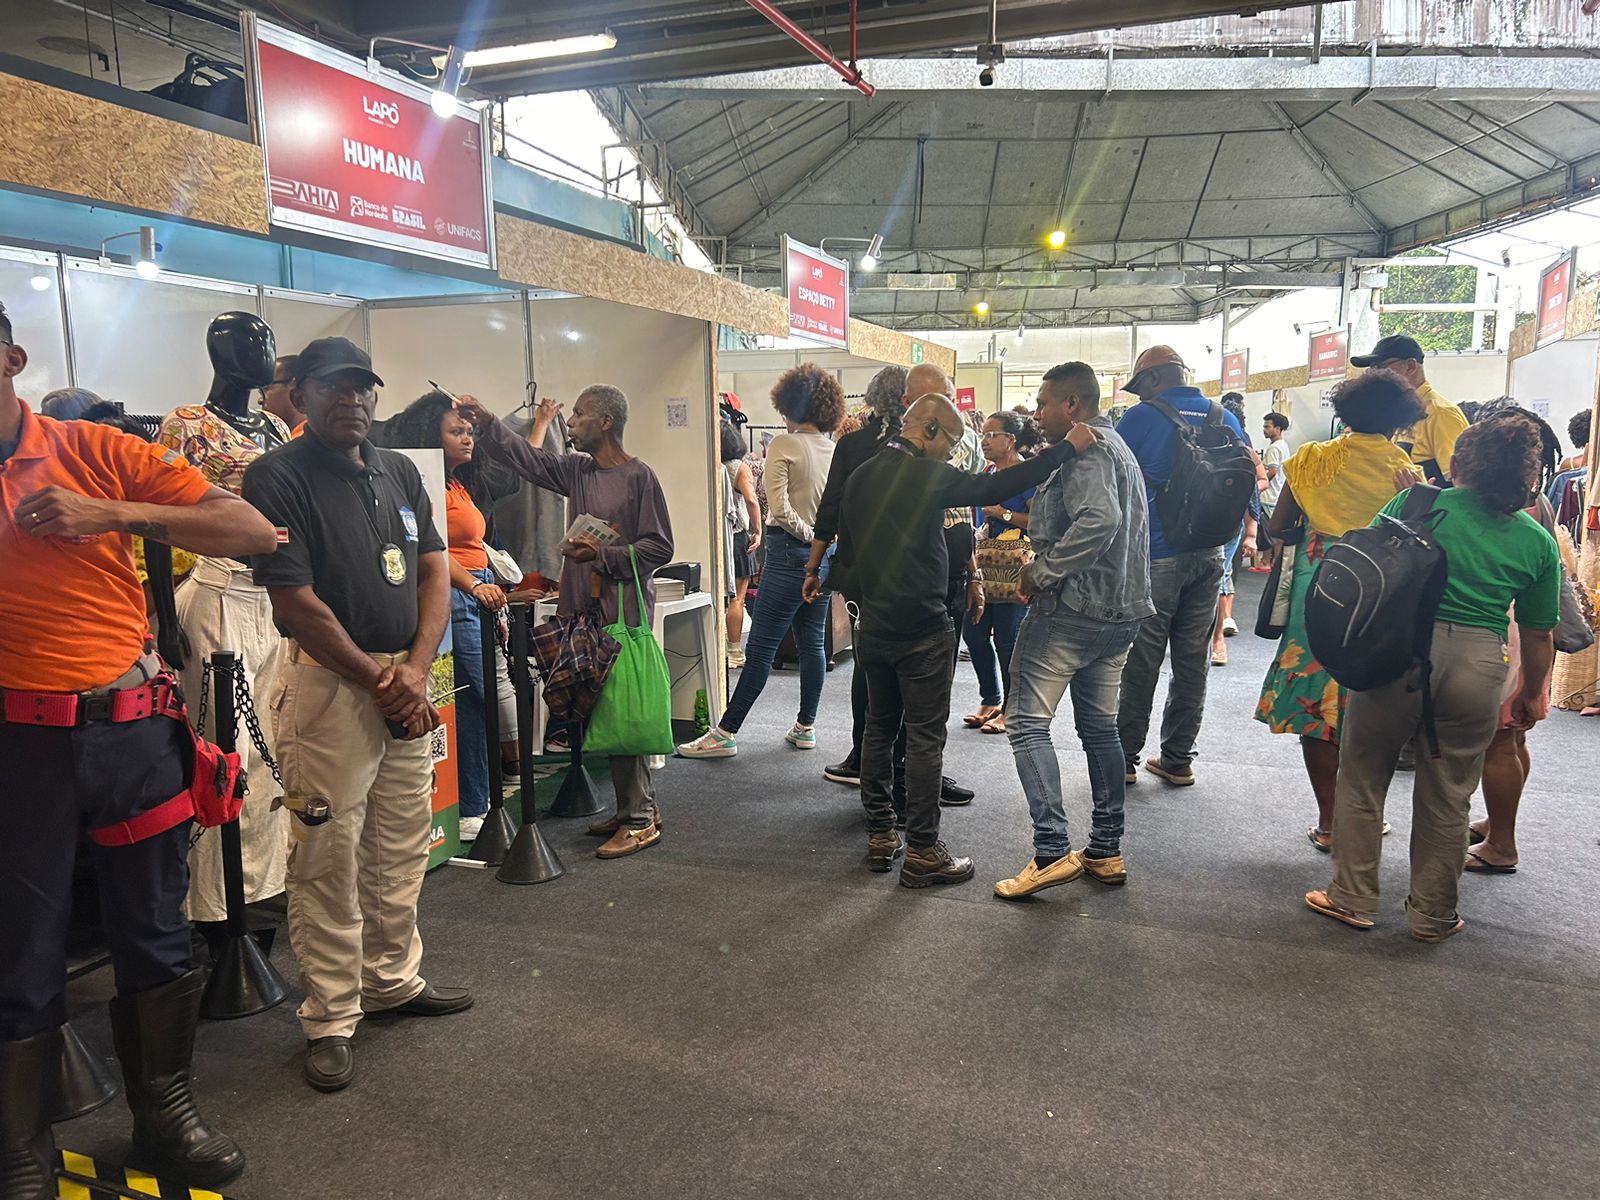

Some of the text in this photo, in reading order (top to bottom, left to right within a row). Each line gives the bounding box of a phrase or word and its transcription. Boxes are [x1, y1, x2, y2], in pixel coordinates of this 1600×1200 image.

[363, 96, 399, 125] LAPÔ
[343, 138, 425, 184] HUMANA
[271, 177, 339, 212] BAHIA
[364, 200, 380, 211] Banco
[392, 208, 426, 230] BRASIL
[447, 222, 481, 241] UNIFACS
[798, 286, 835, 310] ESPAÇO BETTY
[429, 825, 445, 844] NA
